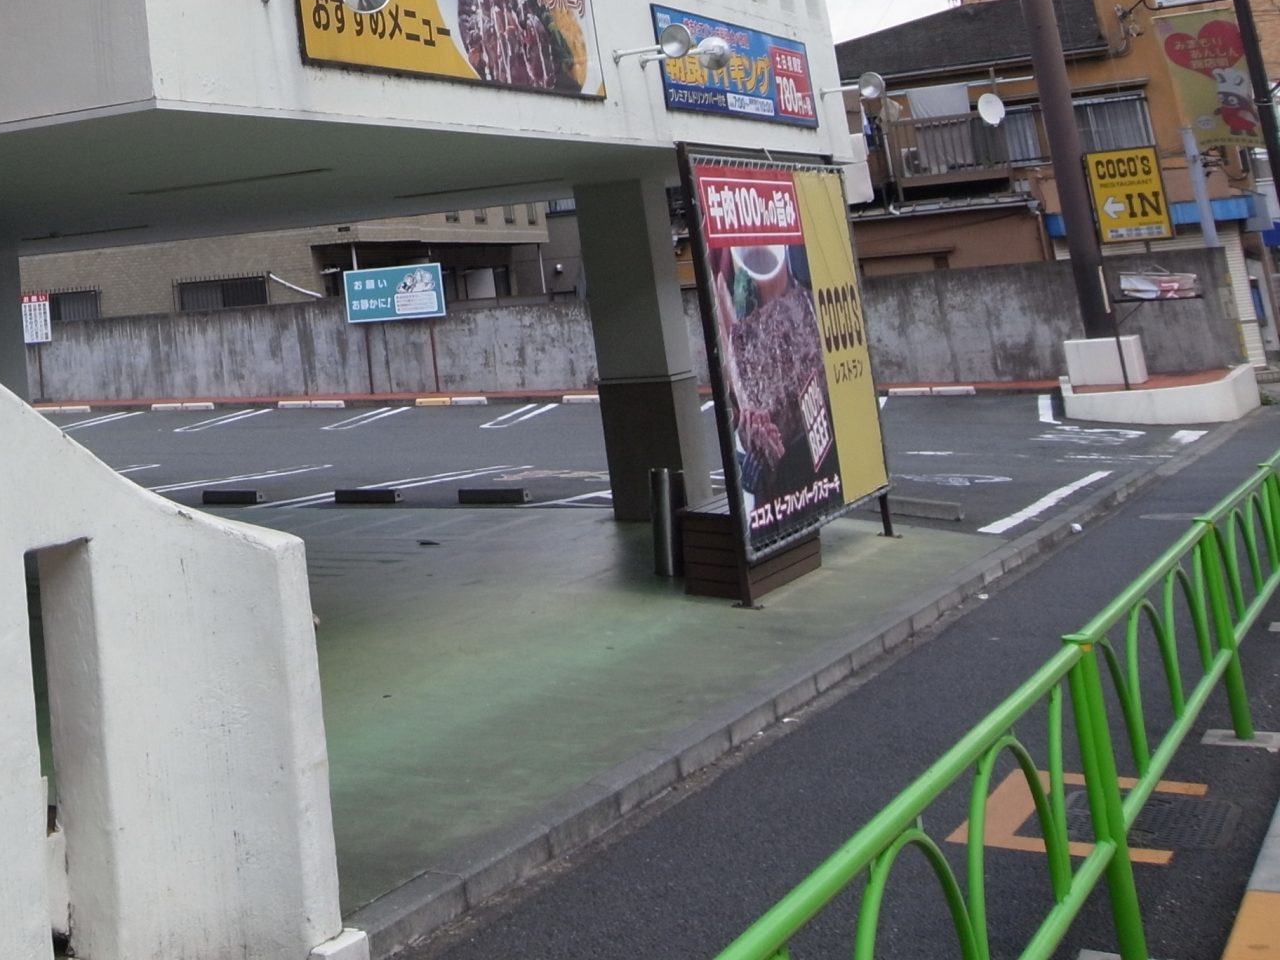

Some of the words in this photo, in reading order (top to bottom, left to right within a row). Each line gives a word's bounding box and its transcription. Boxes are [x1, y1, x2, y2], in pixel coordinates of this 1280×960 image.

[1095, 155, 1152, 180] COCO'S
[1125, 191, 1162, 218] IN
[818, 281, 863, 354] COCO'S
[833, 359, 863, 385] レストラン
[751, 502, 774, 529] ココス
